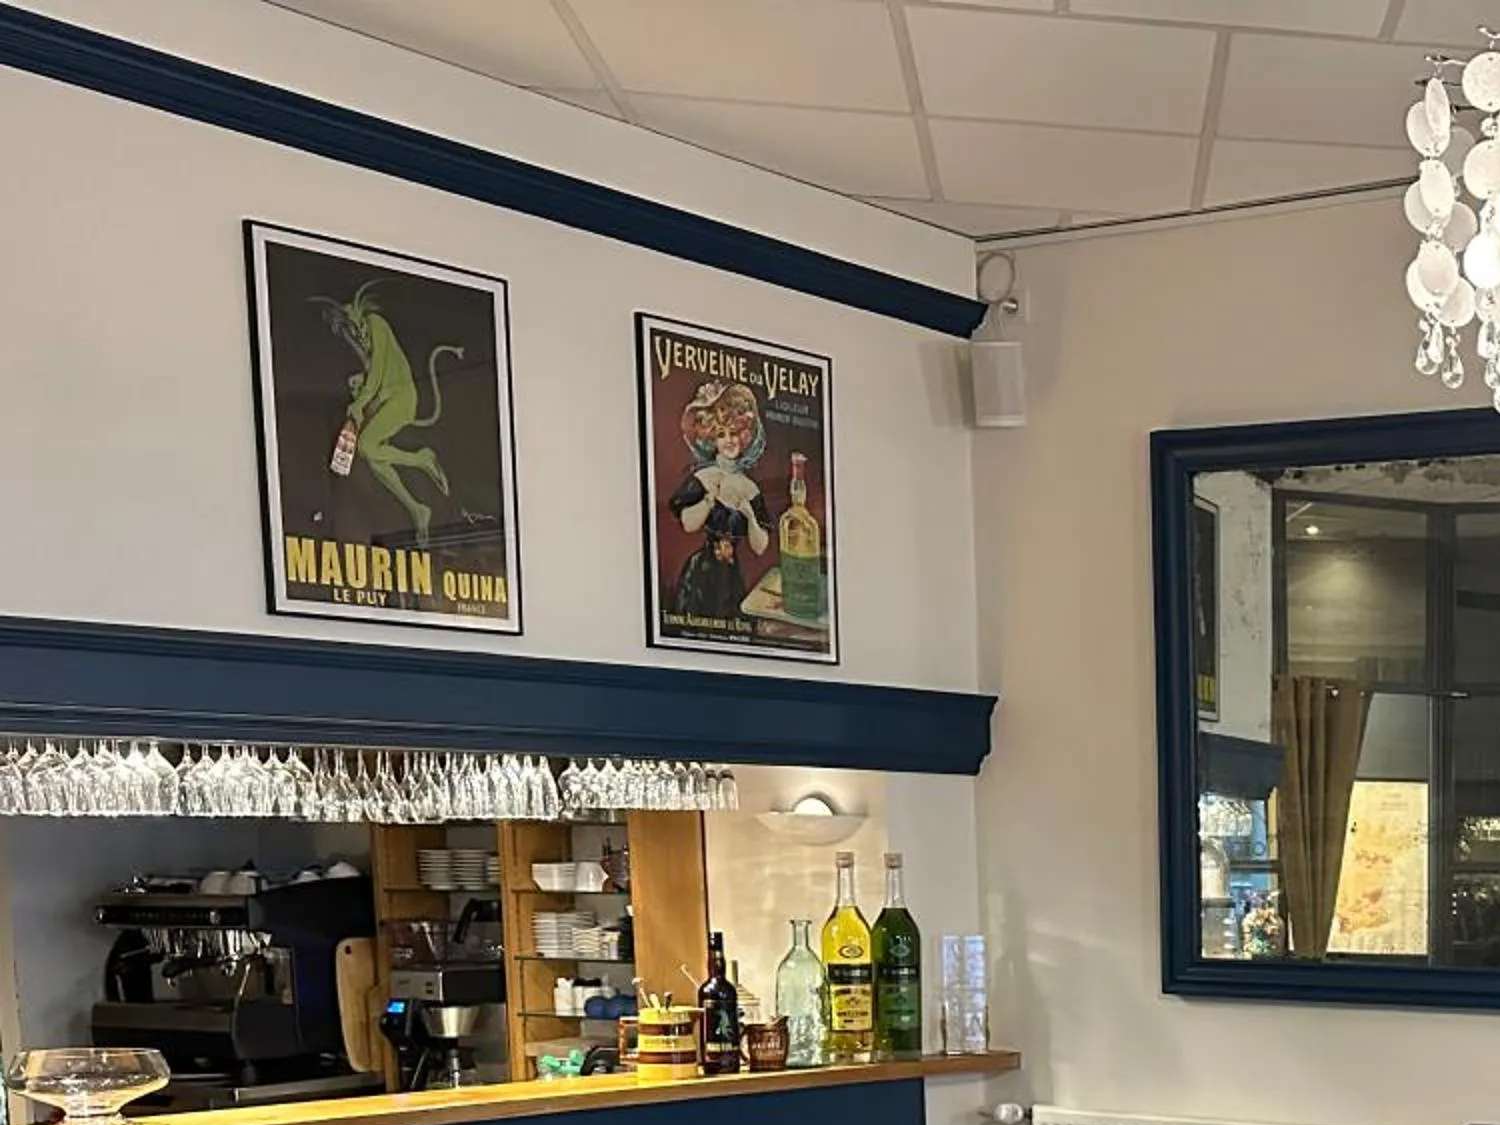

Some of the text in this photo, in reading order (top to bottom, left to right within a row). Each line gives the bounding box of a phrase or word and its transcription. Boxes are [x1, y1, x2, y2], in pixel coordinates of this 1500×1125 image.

[655, 336, 748, 382] VERVEINE
[764, 362, 819, 399] VELAY
[285, 536, 507, 602] MAURIN QUINA
[333, 587, 387, 606] LE PUY
